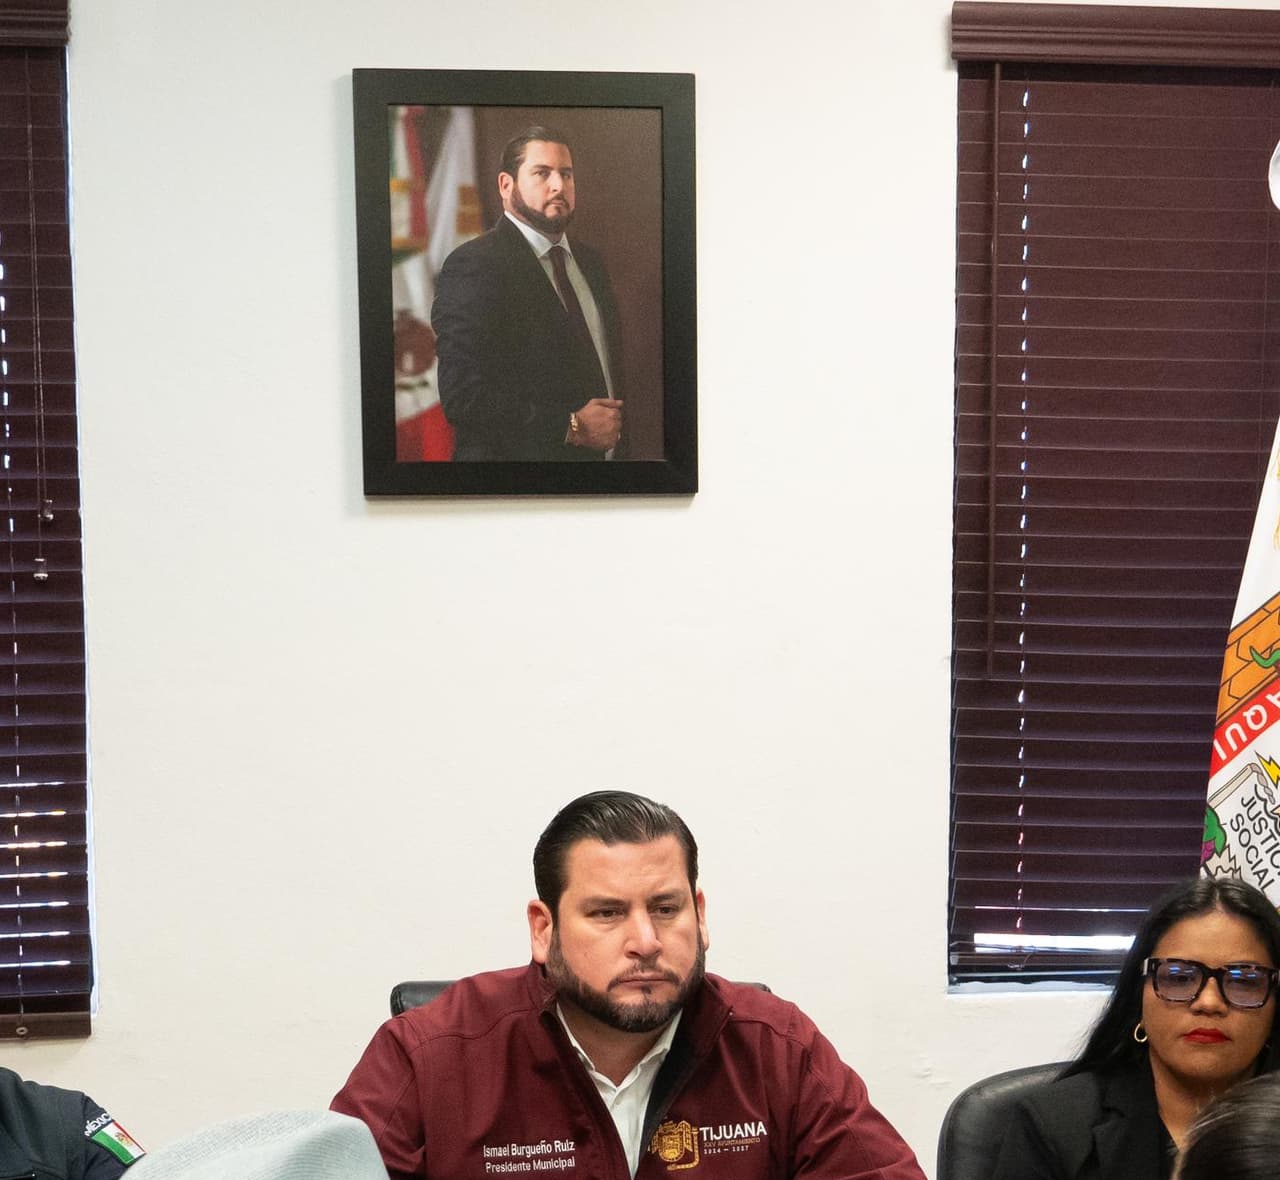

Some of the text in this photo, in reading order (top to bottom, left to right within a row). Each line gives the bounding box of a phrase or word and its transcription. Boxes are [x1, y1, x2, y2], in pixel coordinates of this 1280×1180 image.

[699, 1121, 768, 1141] TIJUANA
[483, 1139, 576, 1158] Ismael Burgueño Ruiz
[485, 1156, 576, 1173] Presidente Municipal
